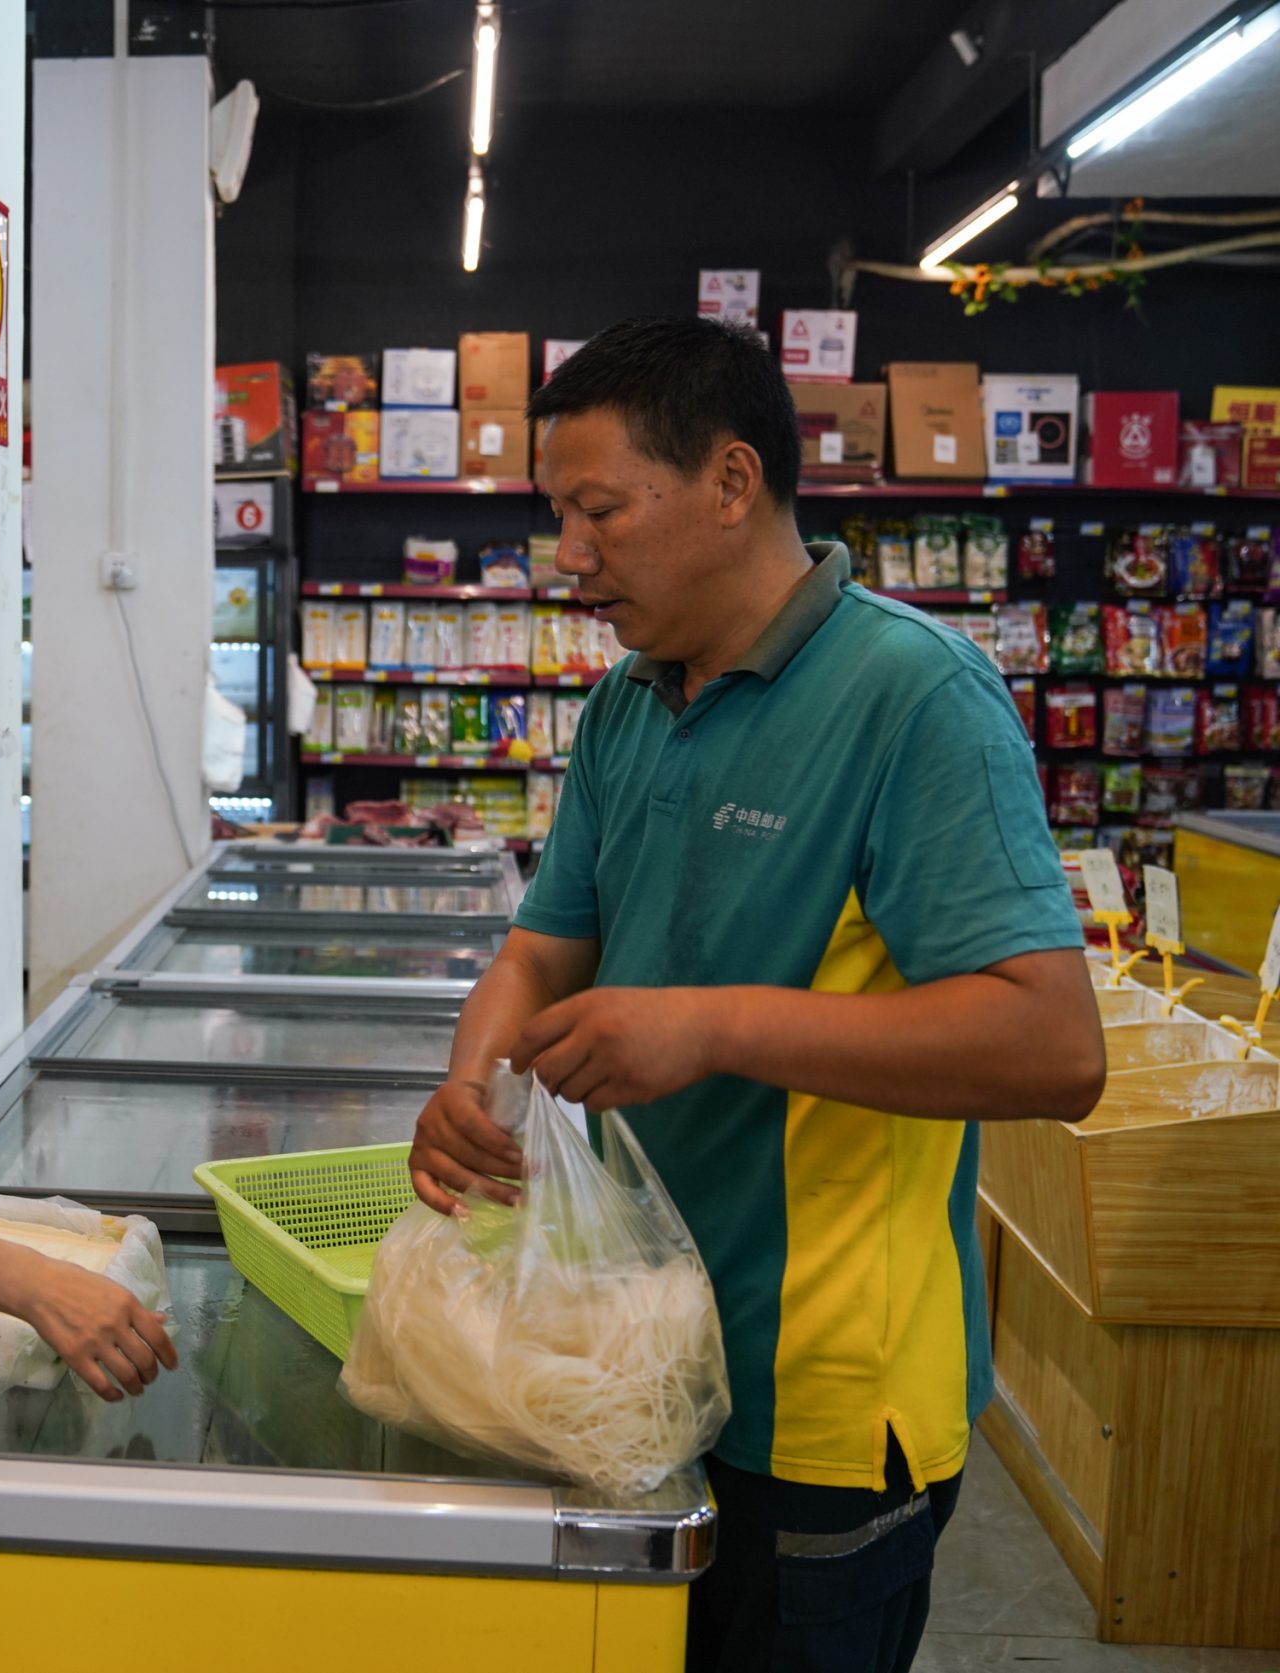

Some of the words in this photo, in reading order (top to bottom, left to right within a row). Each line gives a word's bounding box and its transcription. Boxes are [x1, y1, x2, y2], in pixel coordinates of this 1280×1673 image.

[243, 505, 257, 529] 6
[735, 807, 787, 831] 中国邮政
